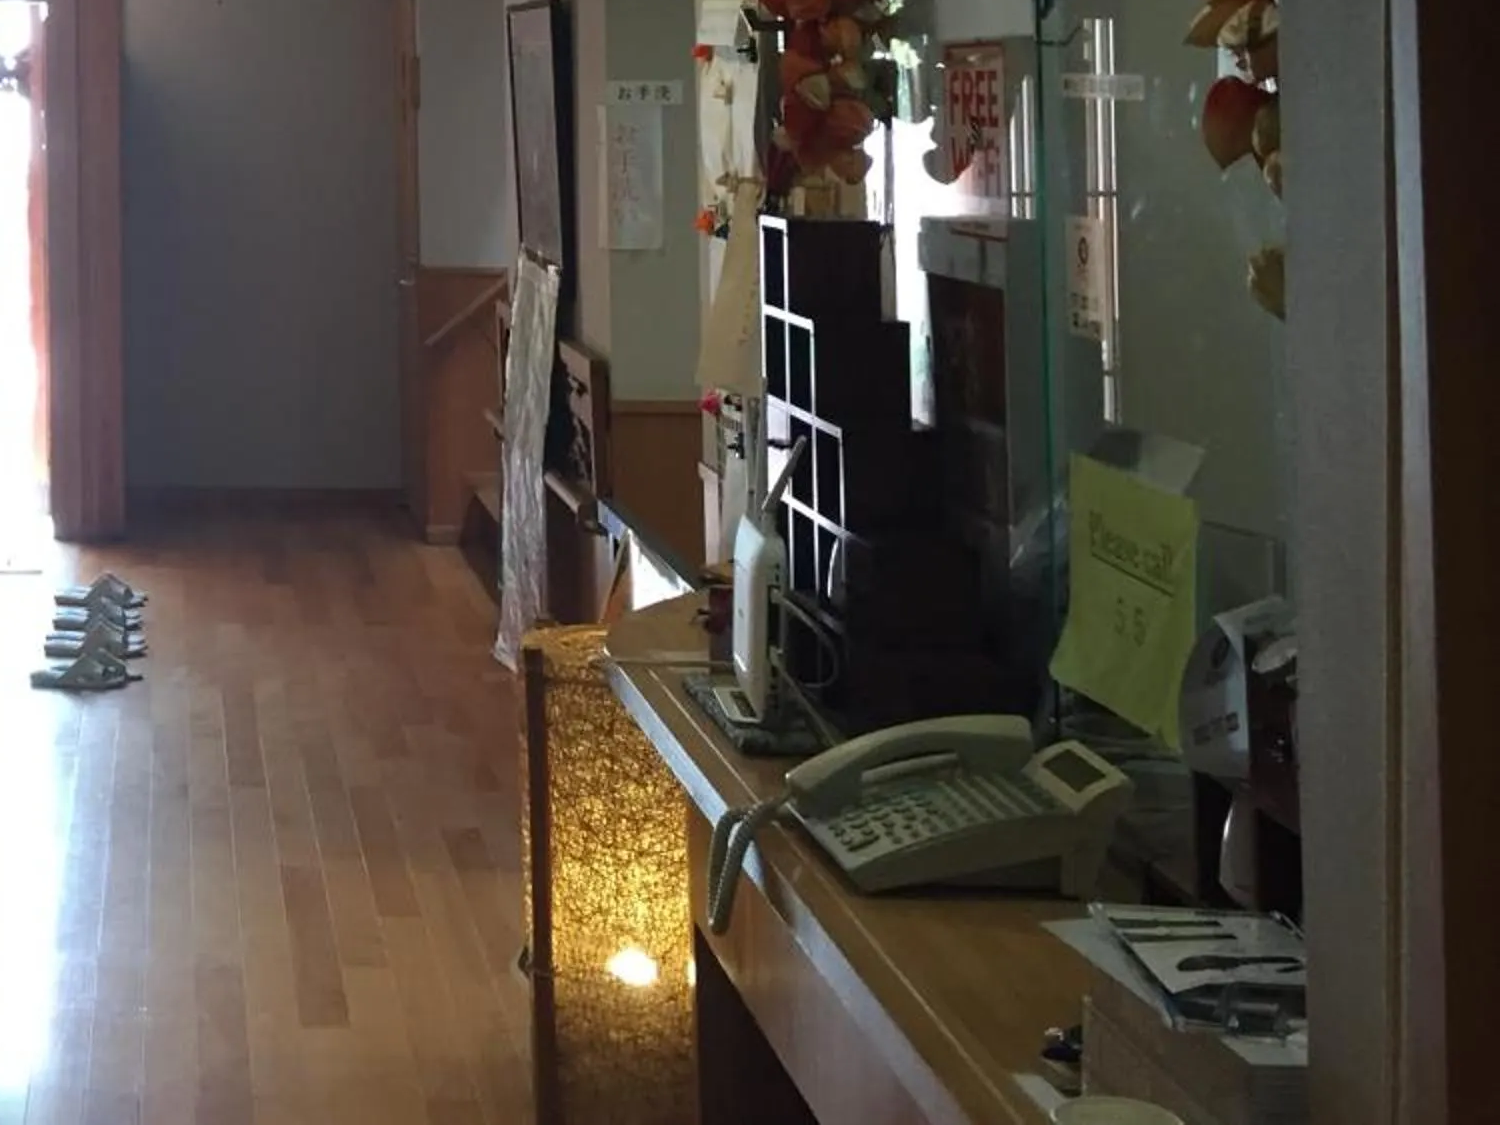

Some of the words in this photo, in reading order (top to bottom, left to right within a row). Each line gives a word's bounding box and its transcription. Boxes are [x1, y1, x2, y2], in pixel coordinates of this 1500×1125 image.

[617, 84, 672, 102] お手洗
[949, 69, 1000, 127] FREE
[1088, 509, 1140, 569] Please
[1142, 541, 1175, 583] call
